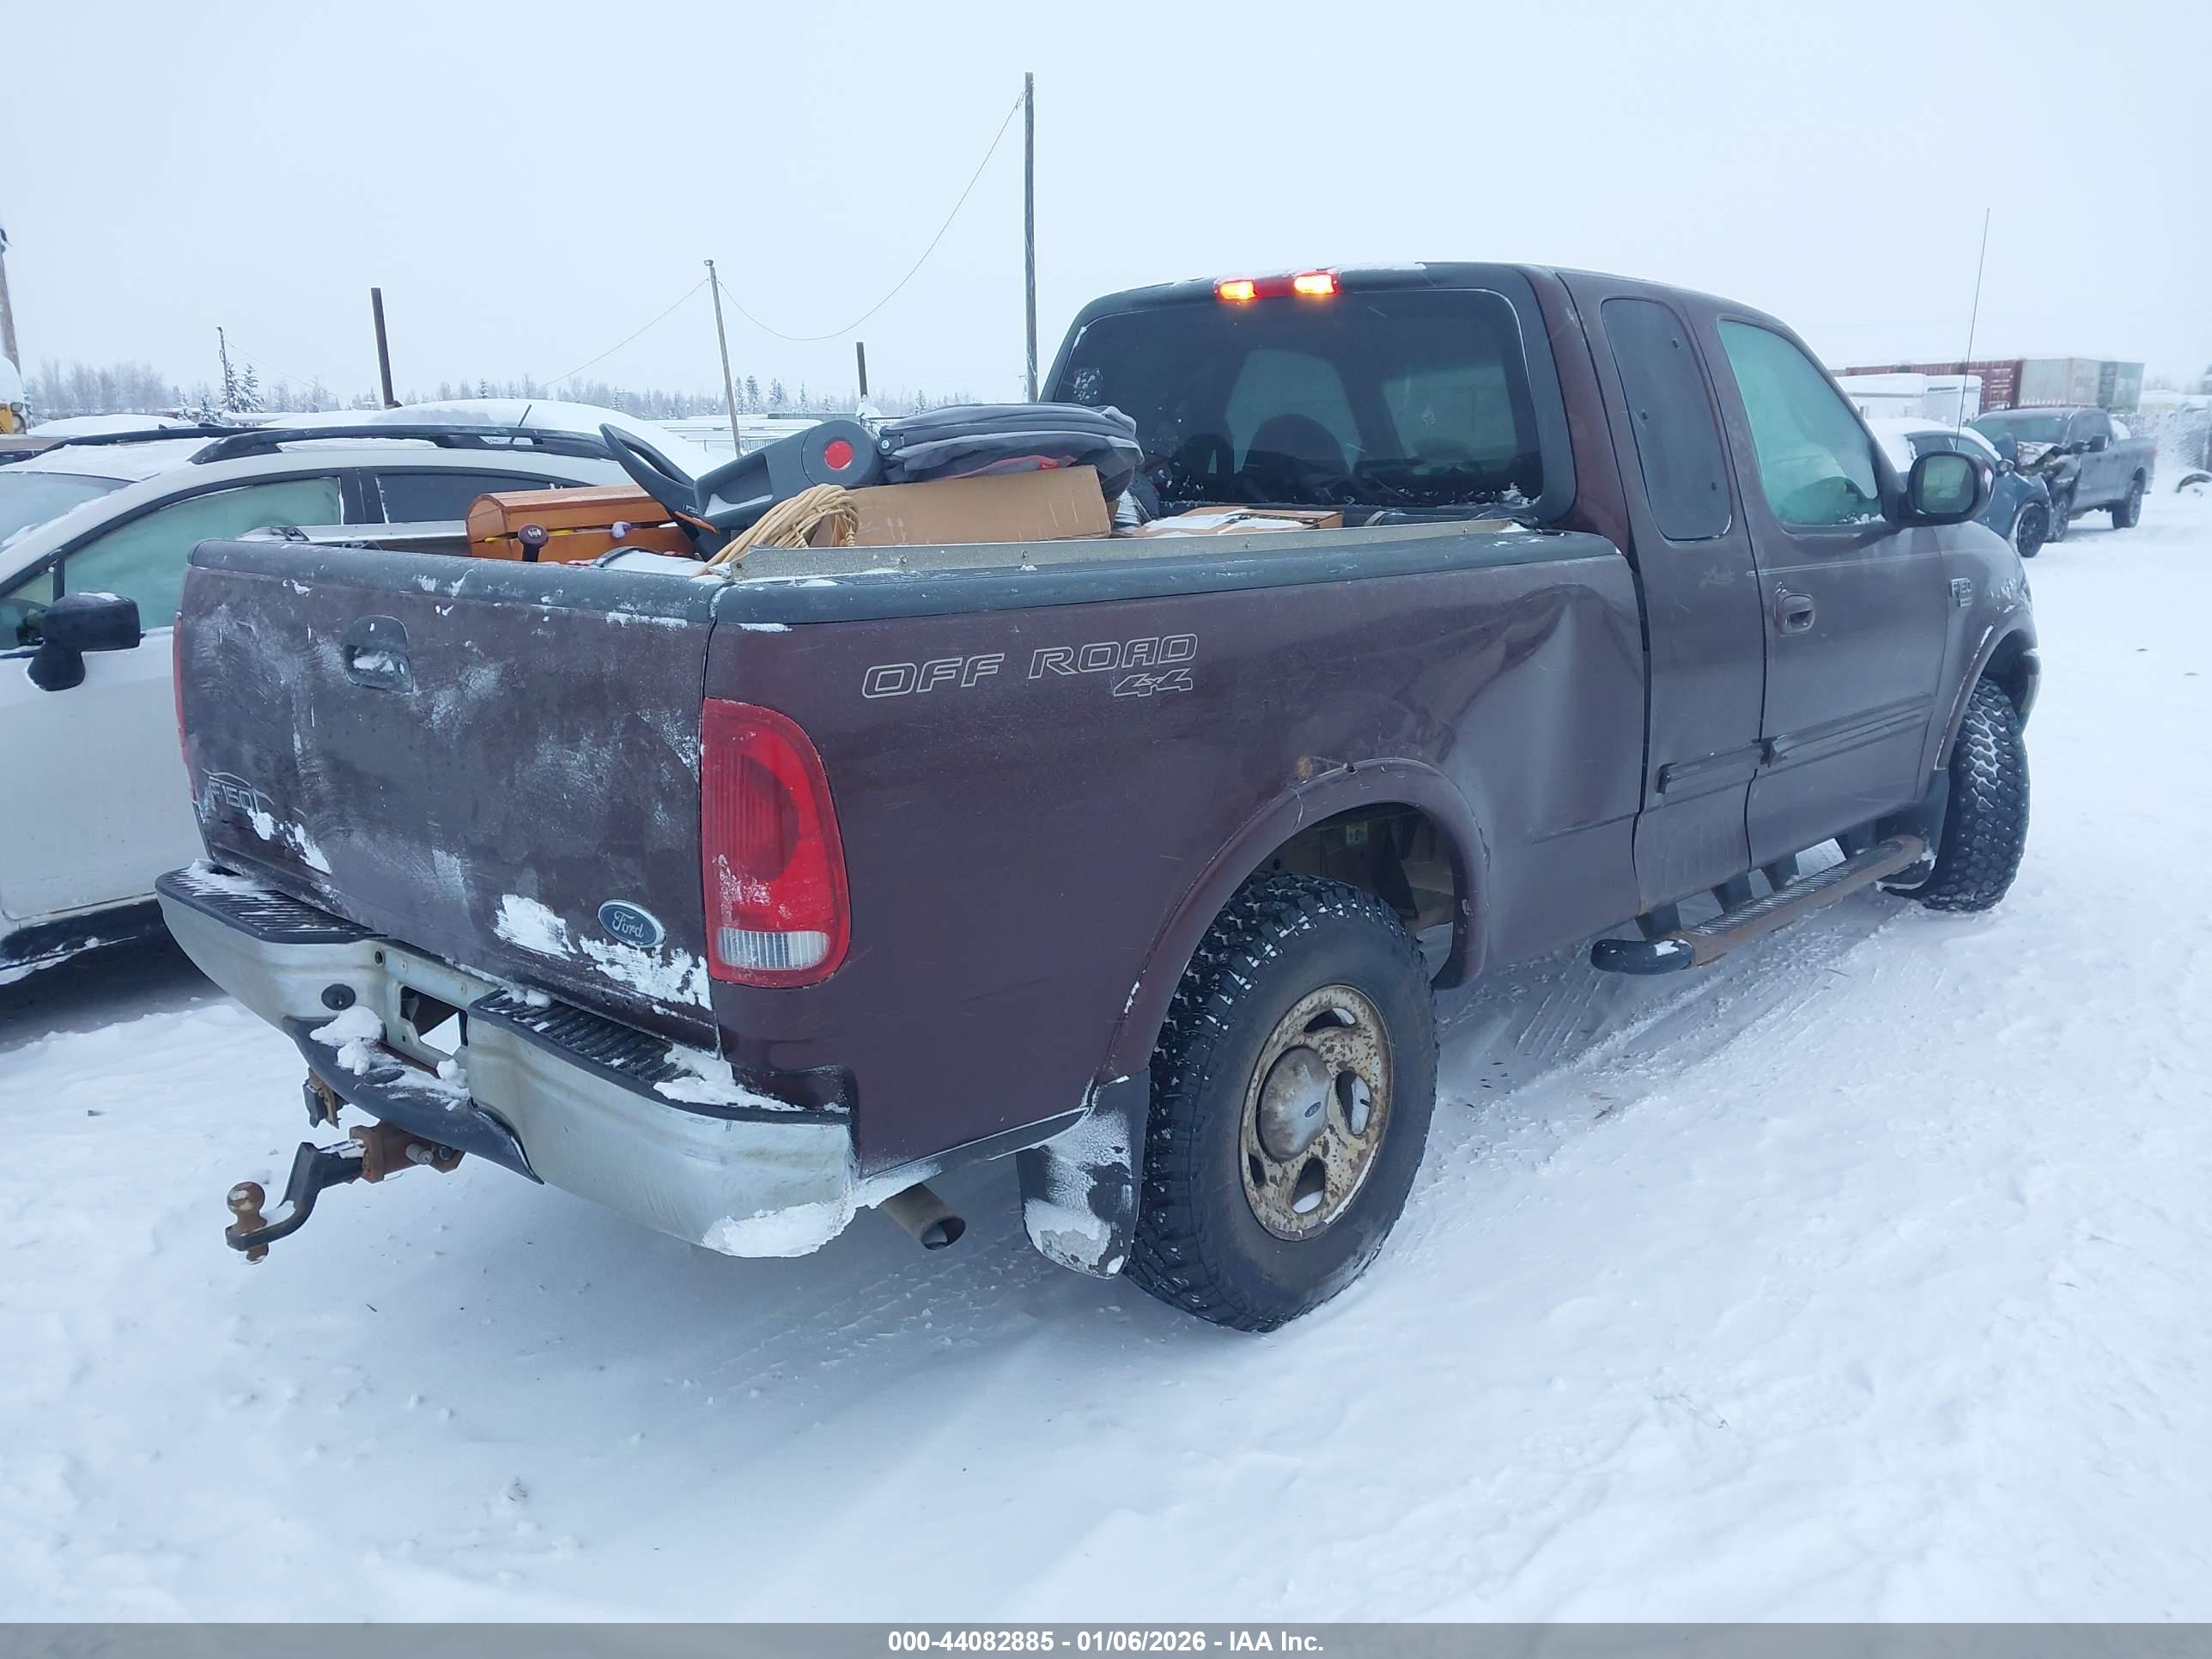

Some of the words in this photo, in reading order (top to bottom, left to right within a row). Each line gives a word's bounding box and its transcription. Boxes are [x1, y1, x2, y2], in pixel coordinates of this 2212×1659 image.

[861, 653, 1006, 698] OFF
[1028, 633, 1199, 679] ROAD
[611, 910, 645, 939] Ford
